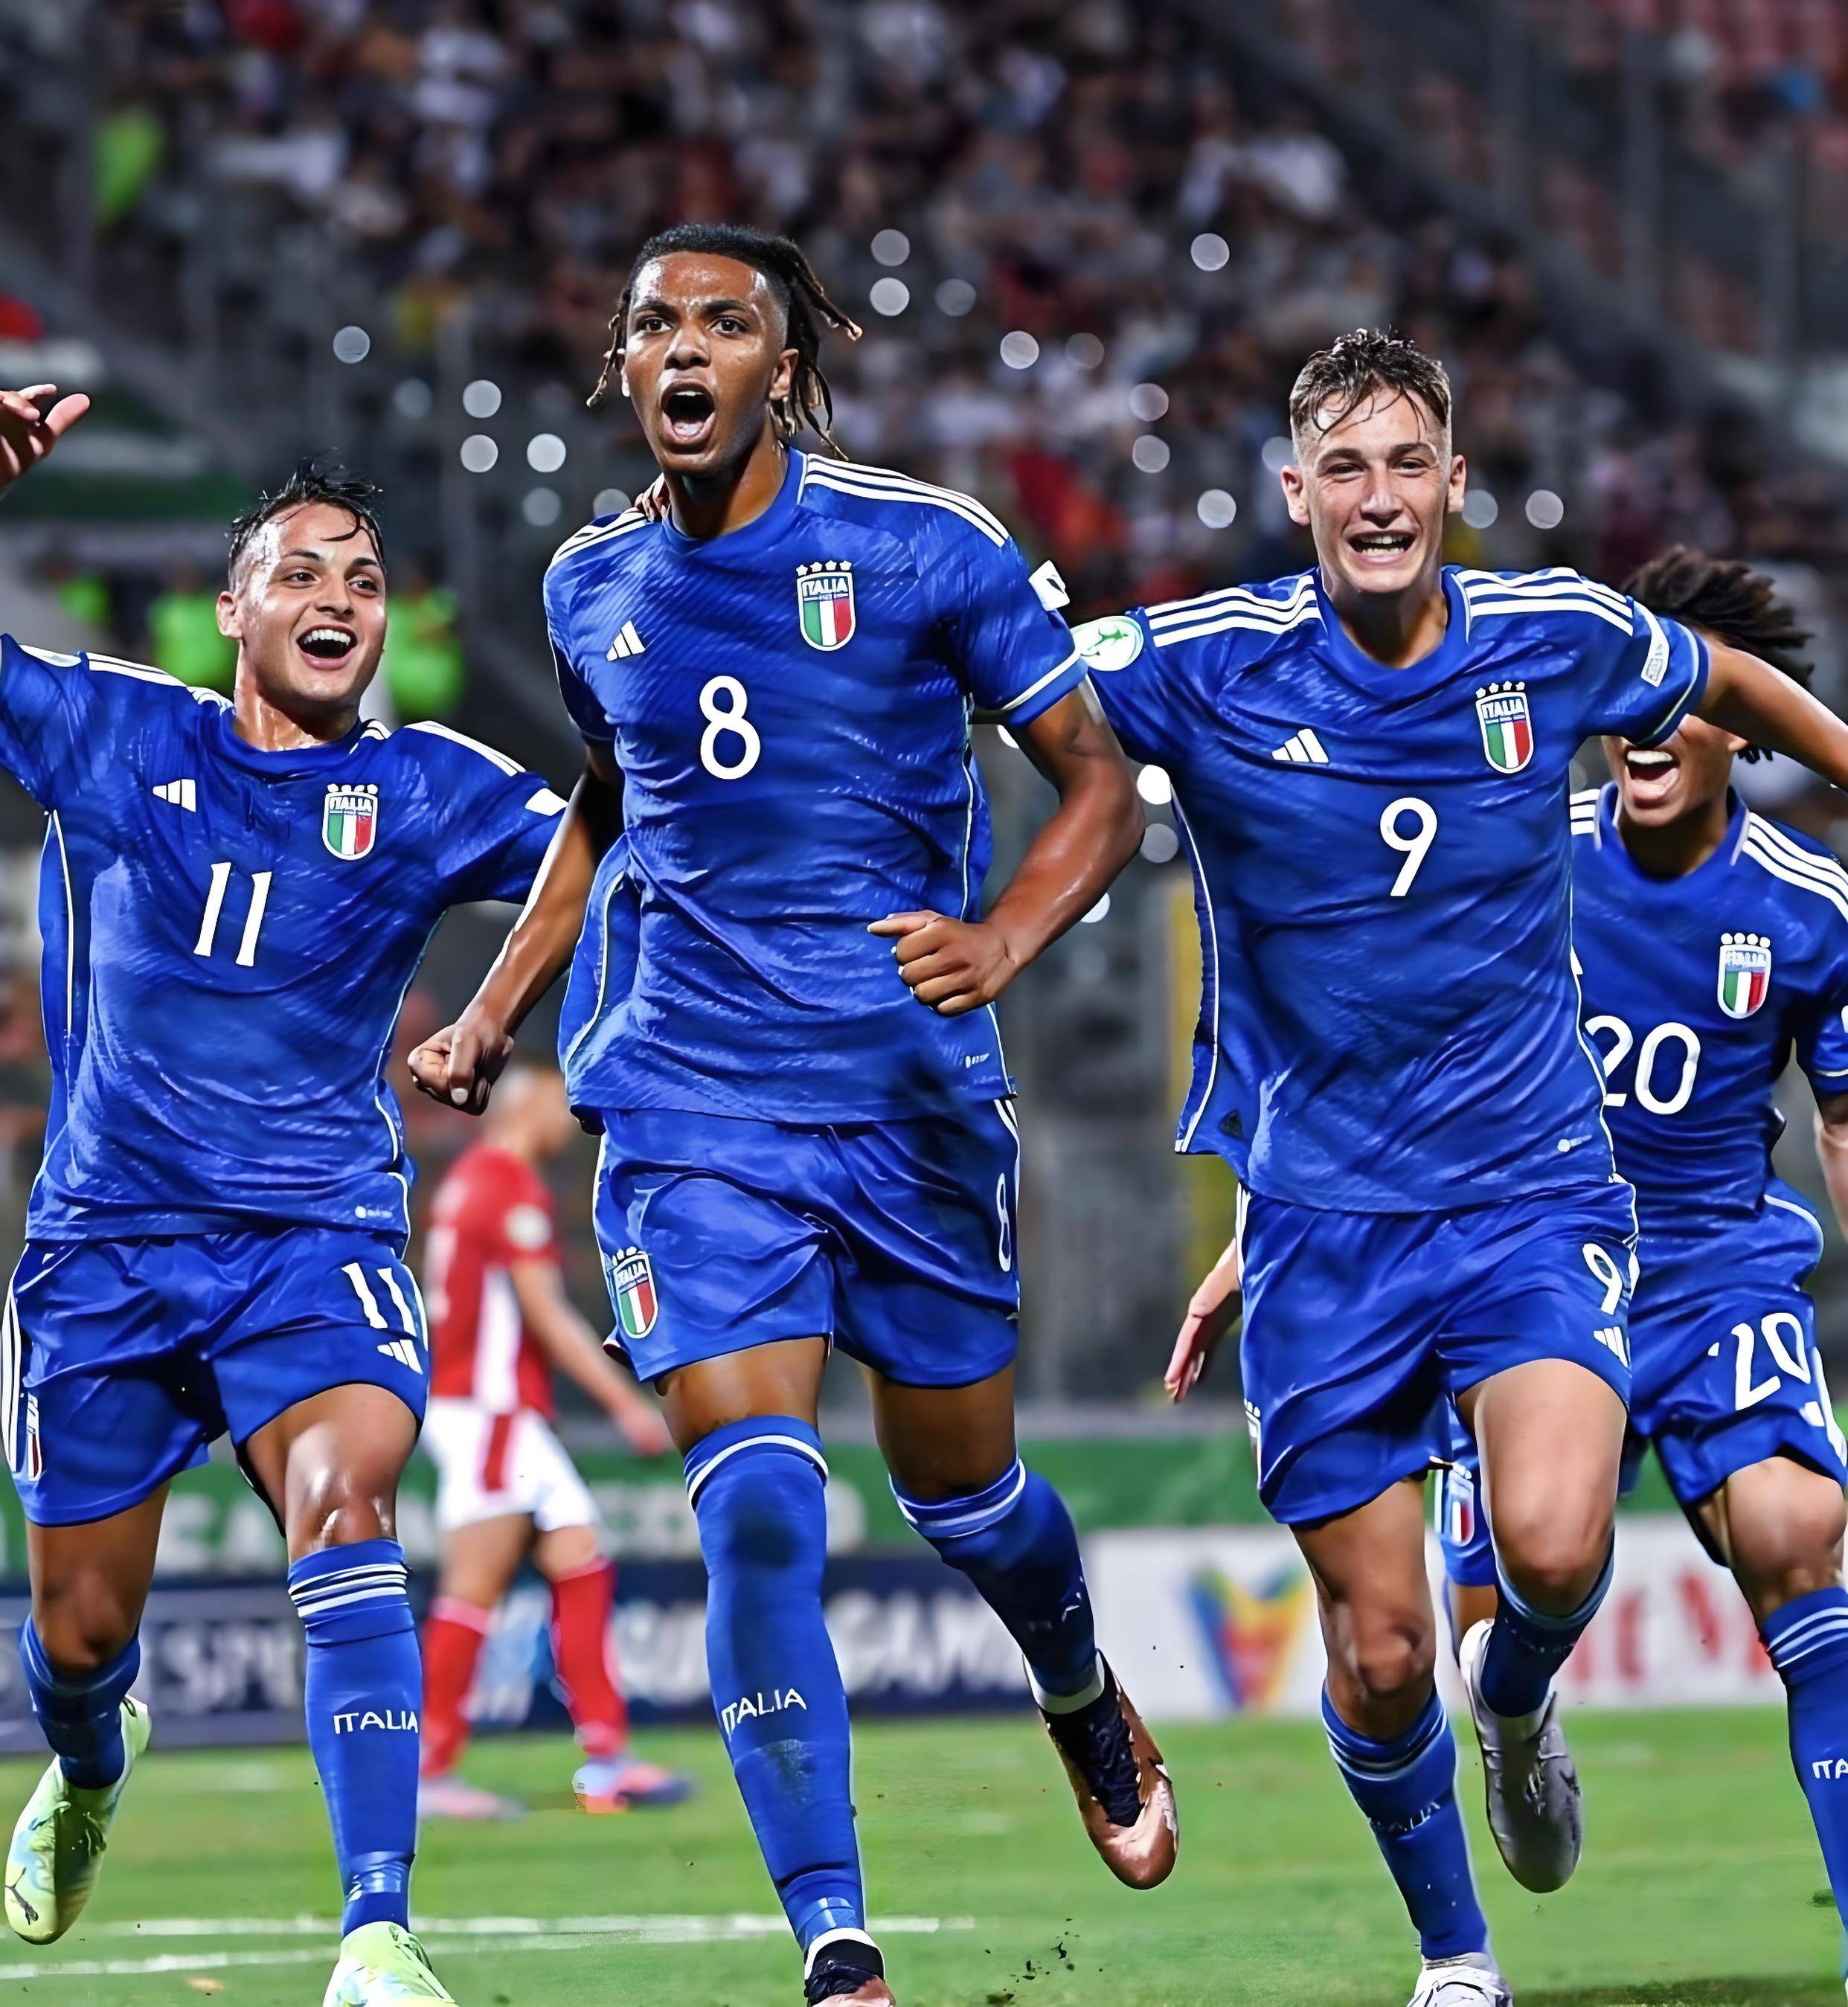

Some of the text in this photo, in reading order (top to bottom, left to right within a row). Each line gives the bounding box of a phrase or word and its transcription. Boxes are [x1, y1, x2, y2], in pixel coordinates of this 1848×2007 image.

[802, 578, 848, 597] ITALIA
[699, 676, 760, 779] 8
[1481, 699, 1525, 719] ITALIA
[330, 797, 373, 812] ITALIA
[1380, 797, 1437, 896] 9
[193, 862, 272, 966] 11
[1585, 1015, 1701, 1114] 20
[996, 1172, 1011, 1271] 8
[341, 1262, 417, 1337] 11
[1582, 1243, 1623, 1315] 9
[1731, 1313, 1811, 1410] 20
[333, 1709, 418, 1734] ITALIA
[722, 1688, 807, 1742] ITALIA
